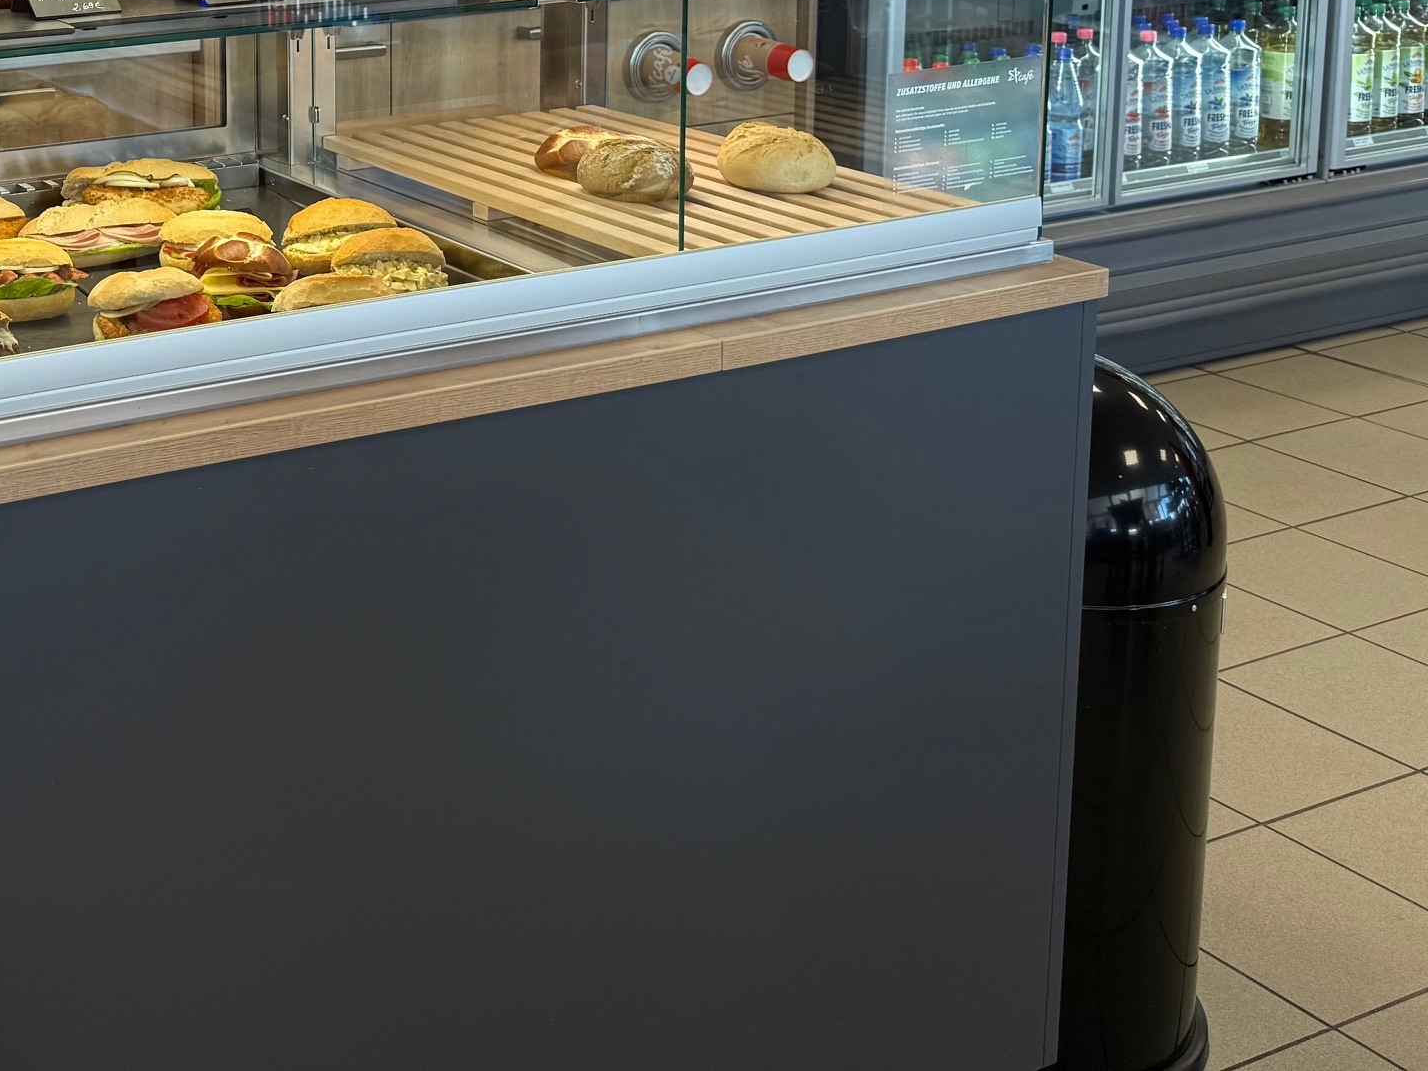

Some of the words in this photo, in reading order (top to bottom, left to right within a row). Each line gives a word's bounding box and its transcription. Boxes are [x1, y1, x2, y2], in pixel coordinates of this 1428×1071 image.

[1018, 69, 1034, 84] café
[896, 81, 947, 97] ZUSATZSTOFFE
[947, 81, 962, 90] UND
[962, 75, 1000, 88] ALLERGENE
